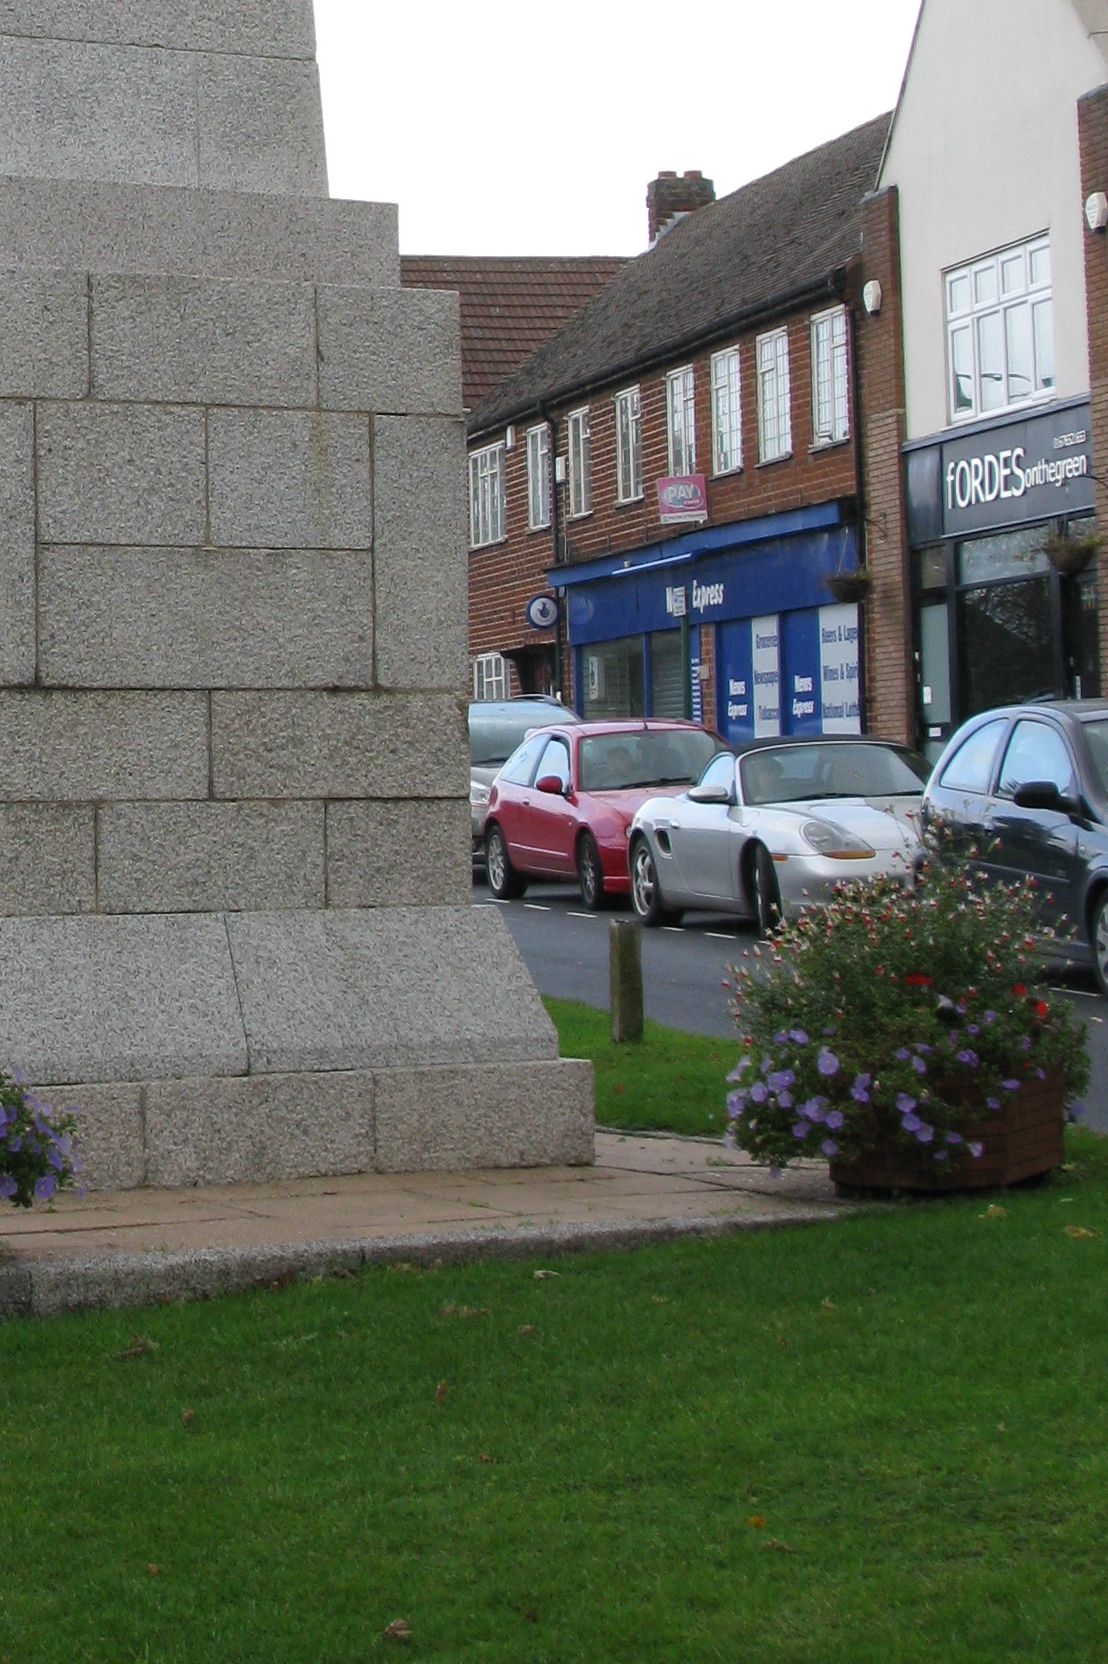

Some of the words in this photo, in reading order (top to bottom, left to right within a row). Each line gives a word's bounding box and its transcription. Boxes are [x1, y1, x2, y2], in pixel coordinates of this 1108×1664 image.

[667, 484, 694, 502] PAY
[692, 579, 724, 614] Express
[728, 701, 748, 720] Express
[793, 698, 814, 718] Express
